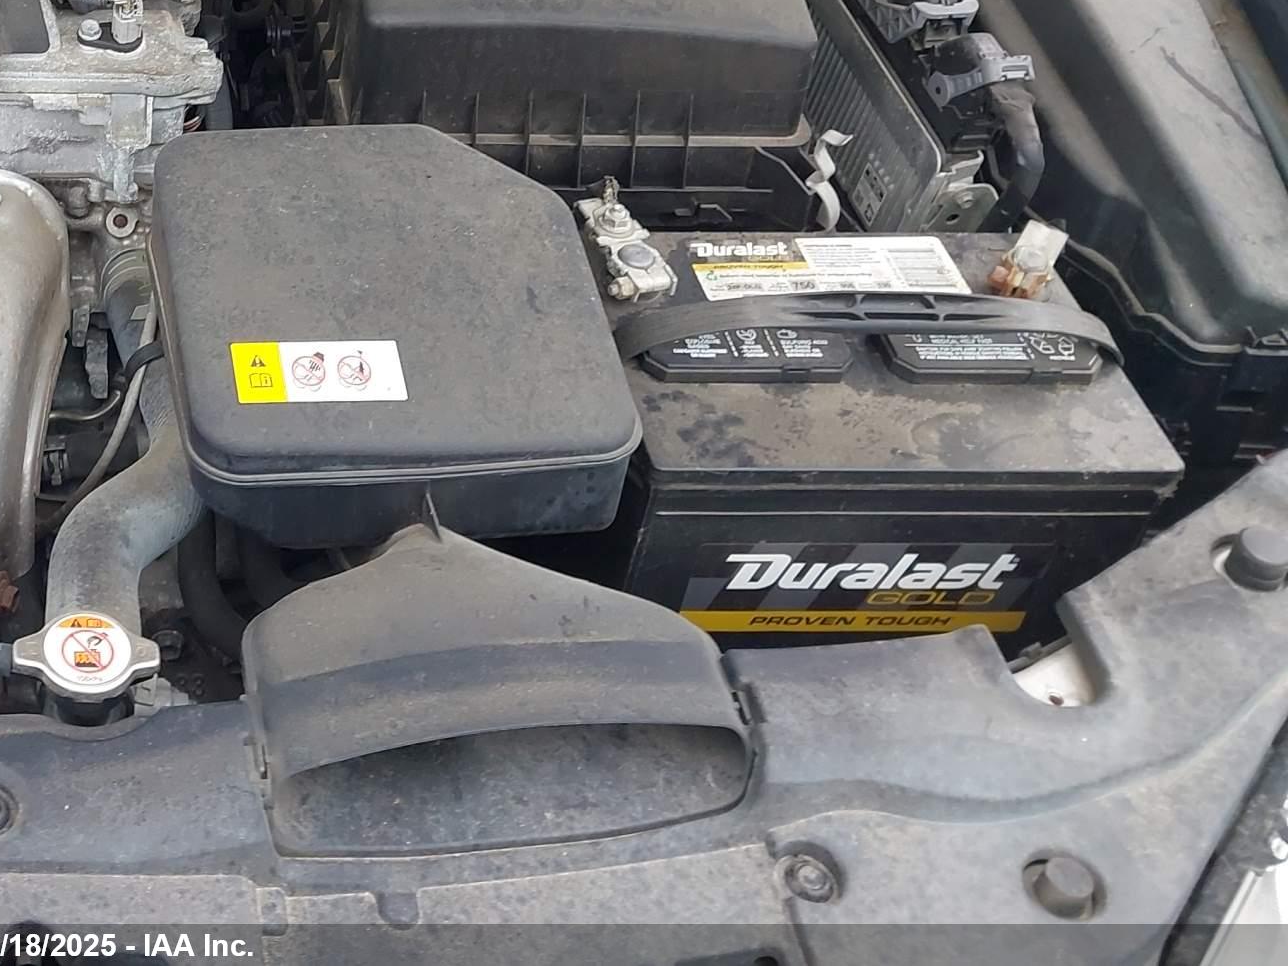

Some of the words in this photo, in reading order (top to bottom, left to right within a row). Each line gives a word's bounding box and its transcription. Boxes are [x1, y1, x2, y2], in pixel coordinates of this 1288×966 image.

[690, 242, 788, 257] Duralast
[725, 553, 1018, 590] Duralast
[867, 591, 995, 605] GOLD
[749, 616, 857, 626] PROVEN
[864, 616, 953, 626] TOUGH
